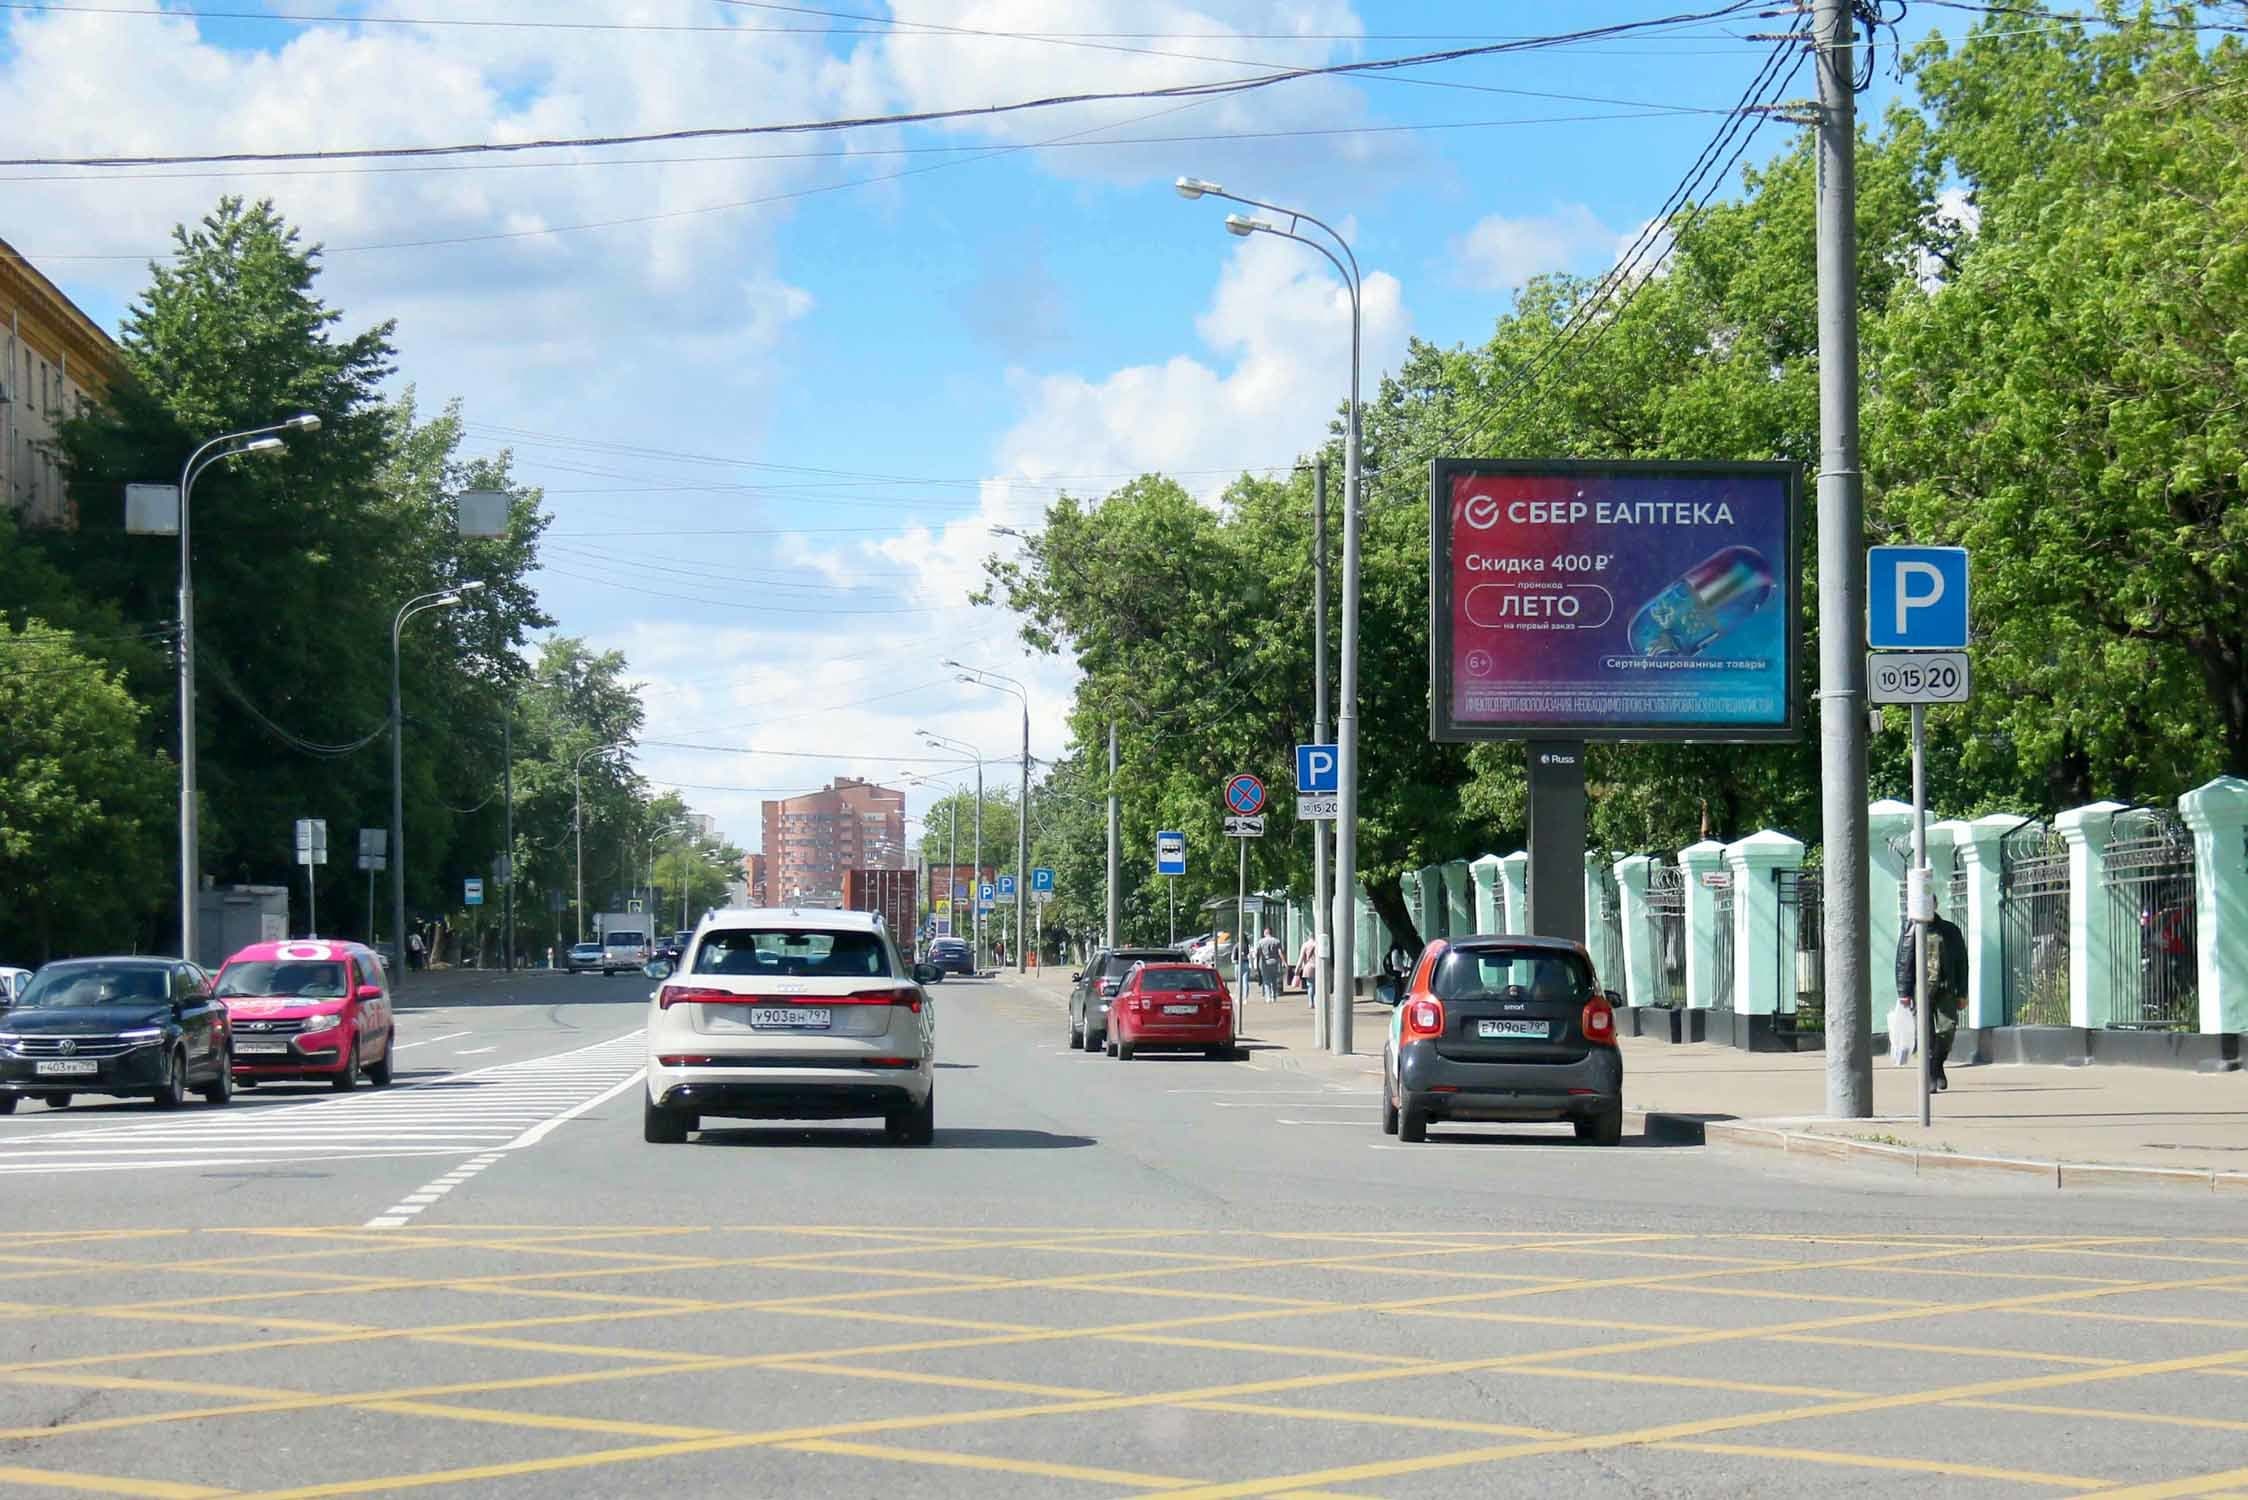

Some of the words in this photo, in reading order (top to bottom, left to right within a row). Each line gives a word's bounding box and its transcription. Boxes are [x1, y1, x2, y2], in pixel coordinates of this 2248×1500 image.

[1507, 502, 1587, 525] СБЕР
[1595, 502, 1735, 525] ЕАПТЕКА
[1465, 554, 1544, 574] Скидка
[1517, 581, 1563, 590] промокод
[1499, 595, 1580, 617] ЛЕТО
[1895, 560, 1945, 635] P
[1516, 621, 1549, 631] первый
[1606, 658, 1723, 670] Сертифицированные
[1726, 660, 1766, 670] товары
[1881, 672, 1896, 686] 10
[1902, 670, 1921, 686] 15
[1928, 667, 1956, 688] 20
[1309, 751, 1333, 786] P
[1313, 803, 1322, 812] 15
[1325, 802, 1337, 813] 20
